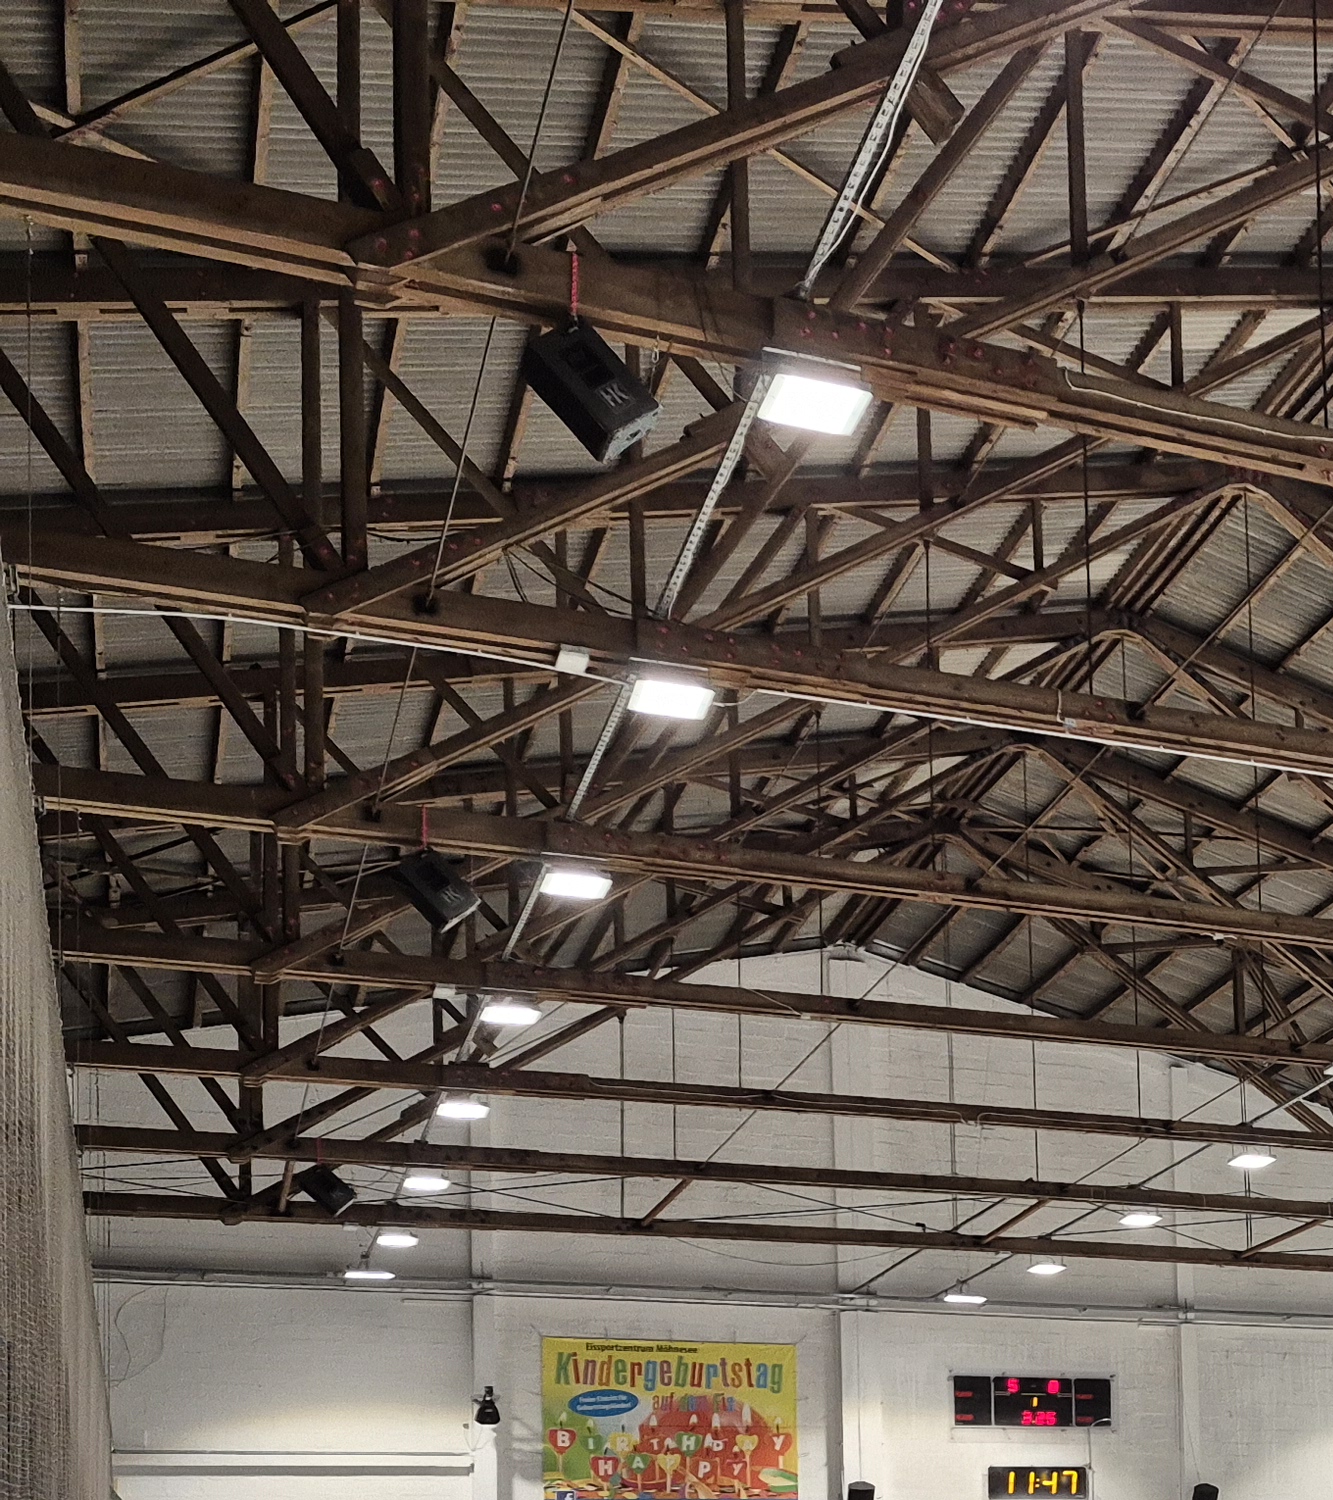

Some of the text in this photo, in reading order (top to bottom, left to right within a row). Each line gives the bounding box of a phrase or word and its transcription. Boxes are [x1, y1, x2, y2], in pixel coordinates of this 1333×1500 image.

[554, 1351, 784, 1394] Kindergeburtstag
[1007, 1378, 1020, 1393] 5
[652, 1392, 675, 1411] auf
[1007, 1470, 1079, 1495] 11:47
